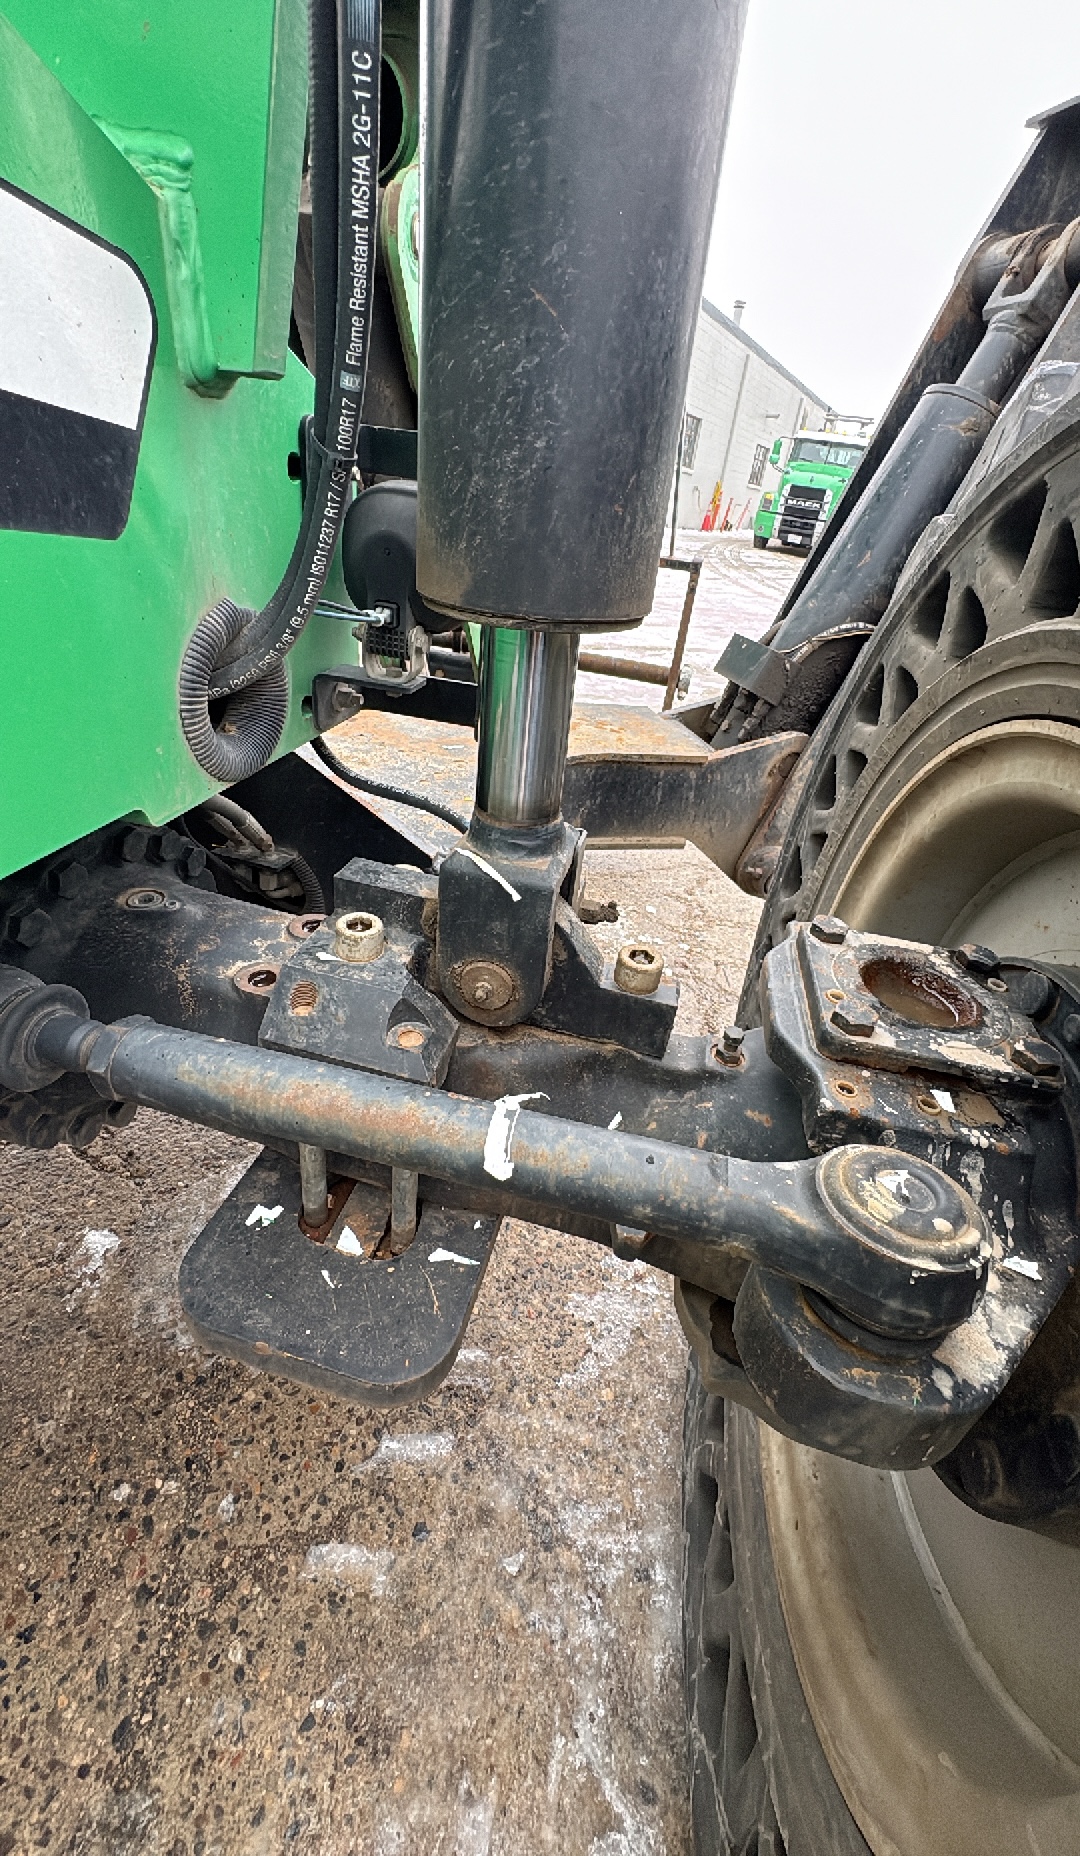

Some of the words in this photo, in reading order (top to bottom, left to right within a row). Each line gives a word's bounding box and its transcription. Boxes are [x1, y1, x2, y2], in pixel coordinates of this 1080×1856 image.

[351, 49, 373, 149] 2G-11C
[351, 154, 371, 219] MSHA
[349, 223, 369, 311] Resistant
[345, 315, 365, 367] Flame
[336, 397, 358, 452] 100R17
[323, 491, 342, 519] R17
[788, 499, 821, 509] MACK
[289, 605, 309, 630] (9.5
